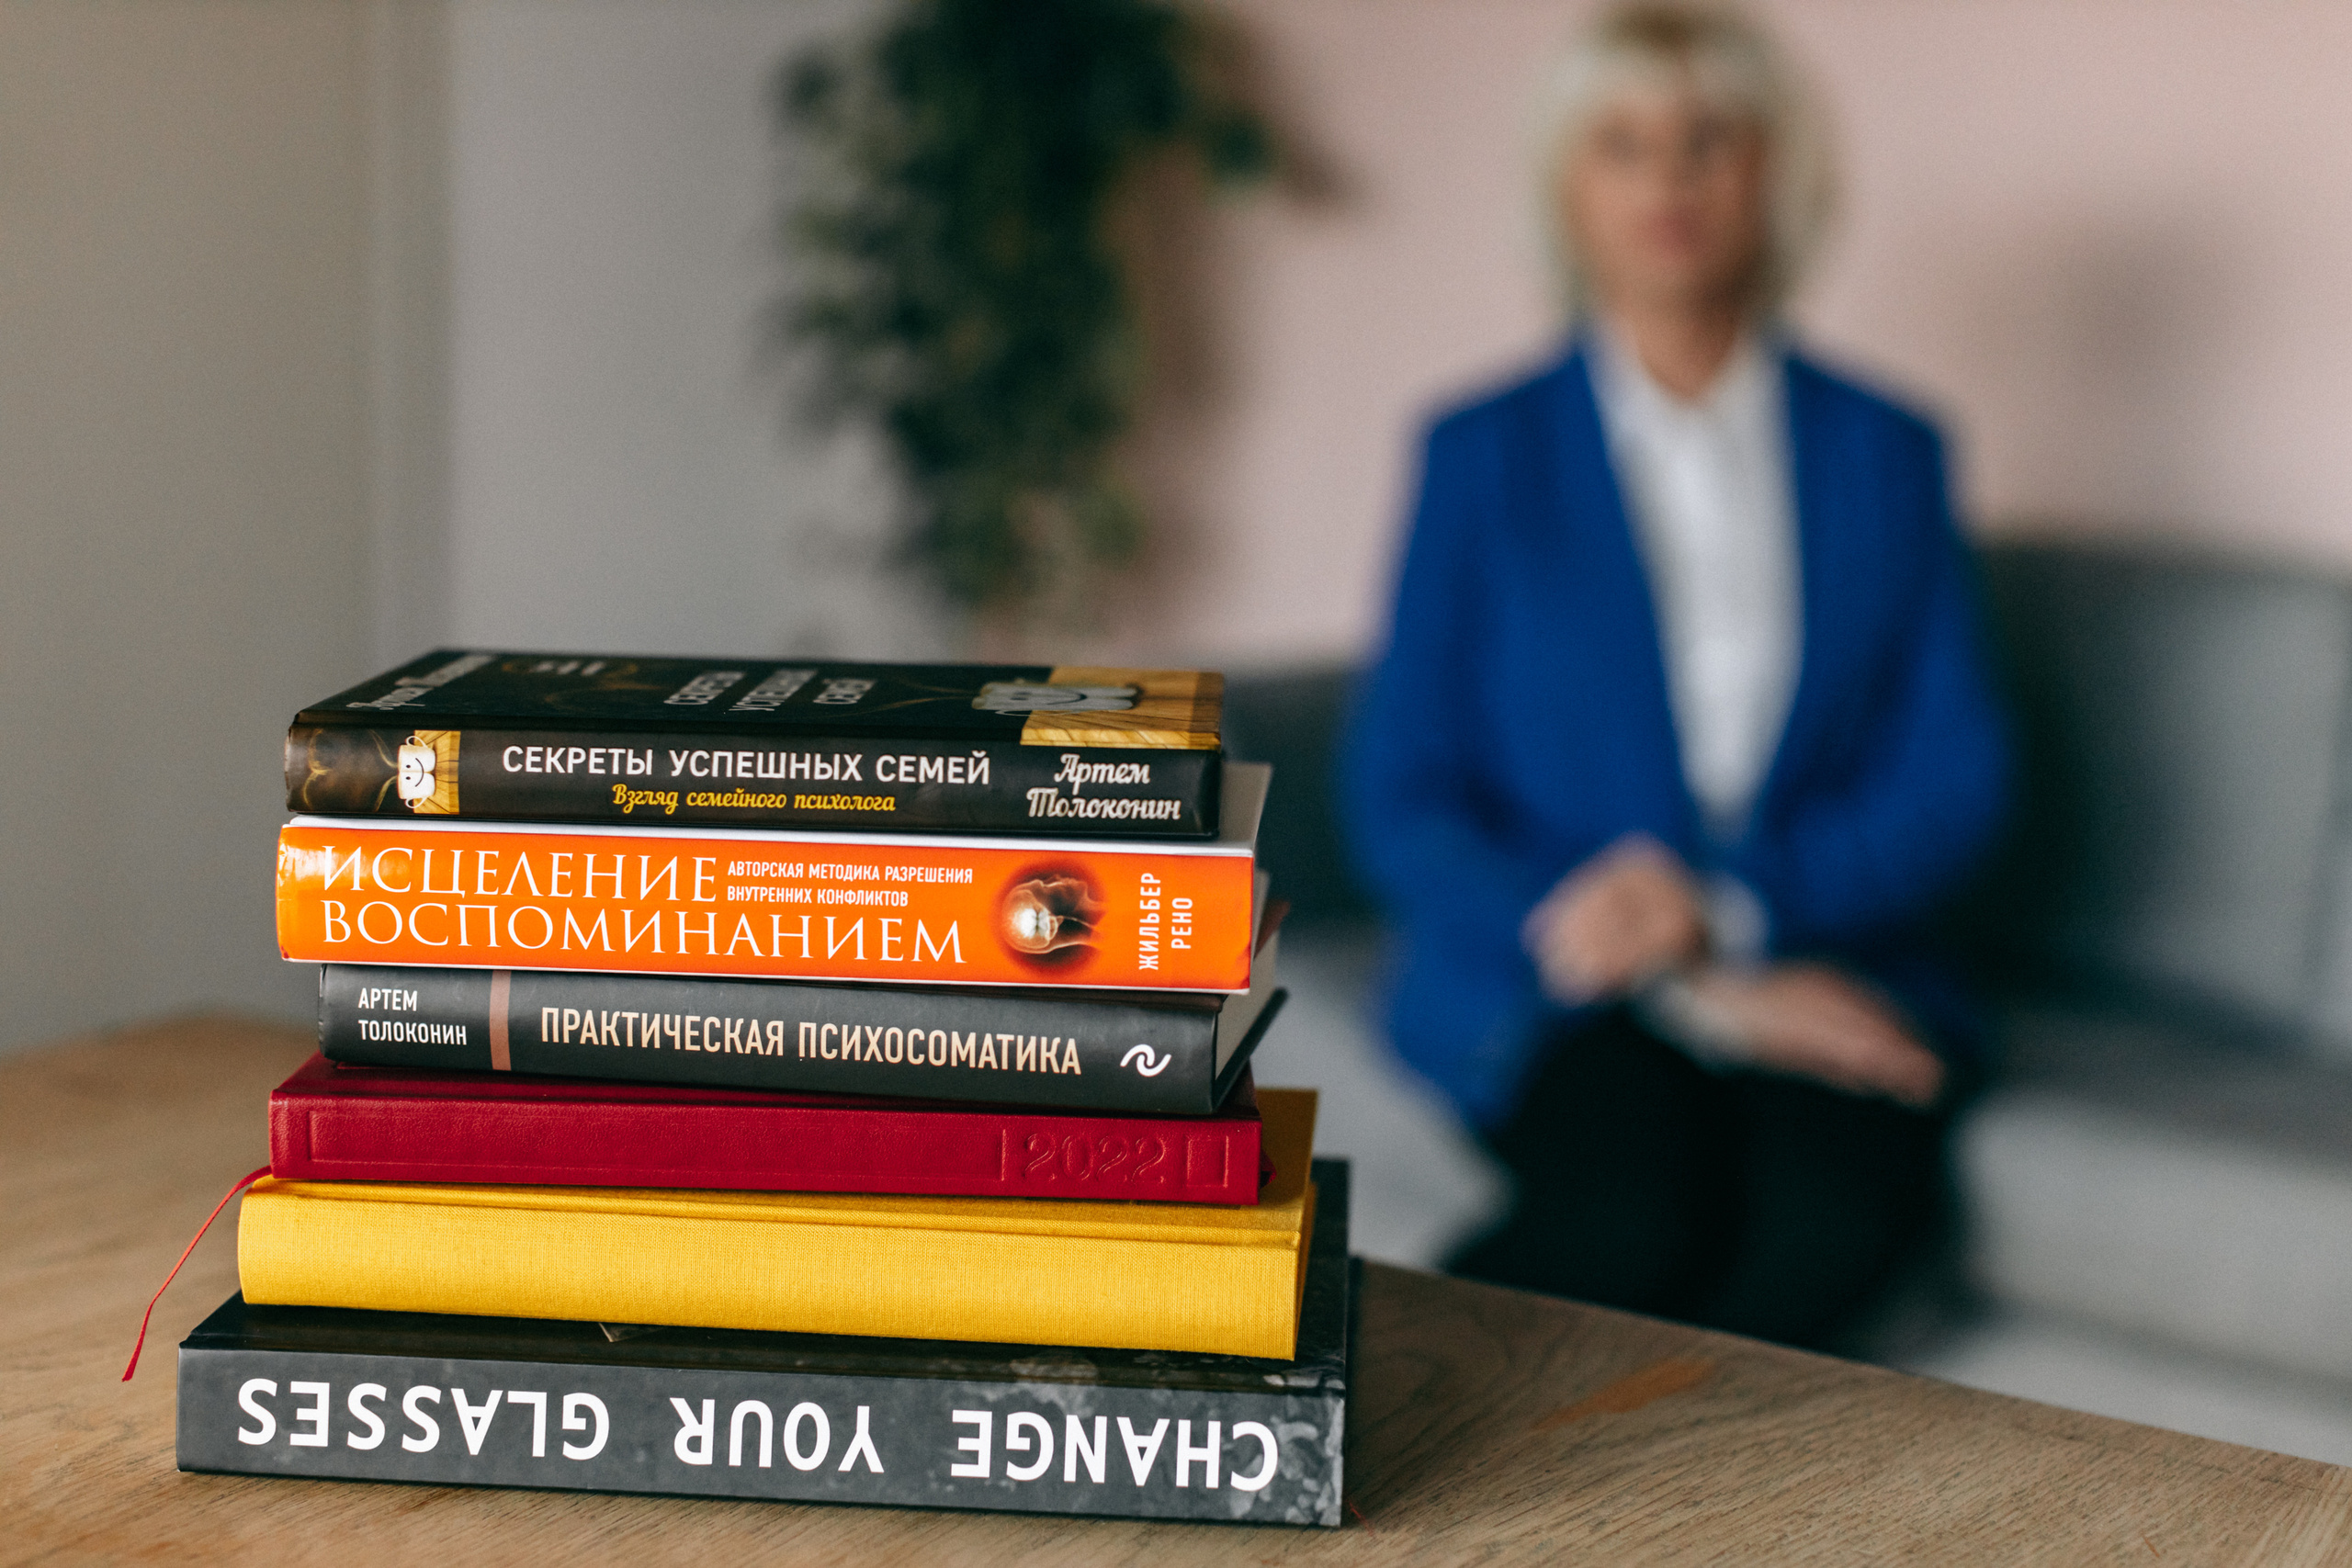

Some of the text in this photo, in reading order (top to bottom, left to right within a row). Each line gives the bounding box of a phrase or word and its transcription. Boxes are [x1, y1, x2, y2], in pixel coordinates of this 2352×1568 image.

[503, 745, 990, 784] СЕКРЕТЫ УСПЕШНЫХ СЕМЕЙ
[1054, 752, 1151, 796] Артем
[612, 783, 897, 815] Взгляд семейного психолога
[1025, 786, 1182, 820] Толоконин
[322, 844, 718, 902] ИСЦЕЛЕНИЕ
[727, 860, 974, 885] АВТОРСКАЯ МЕТОДИКА РАЗРЕШЕНИЯ
[727, 886, 910, 908] ВНУТРЕННИХ КОНФЛИКТОВ
[321, 899, 968, 964] ВОСПОМИНАНИЕМ
[1138, 872, 1161, 971] ЖИЛЬБЕР
[1170, 897, 1193, 950] РЕНО
[357, 987, 418, 1011] АРТЕМ
[358, 1019, 468, 1046] ТОЛОКОНИН
[540, 1007, 1082, 1075] ПРАКТИЧЕСКАЯ ПСИХОСОМАТИКА
[1022, 1131, 1168, 1186] 2022
[237, 1377, 1280, 1493] CHANGE YOUR GLASSES
